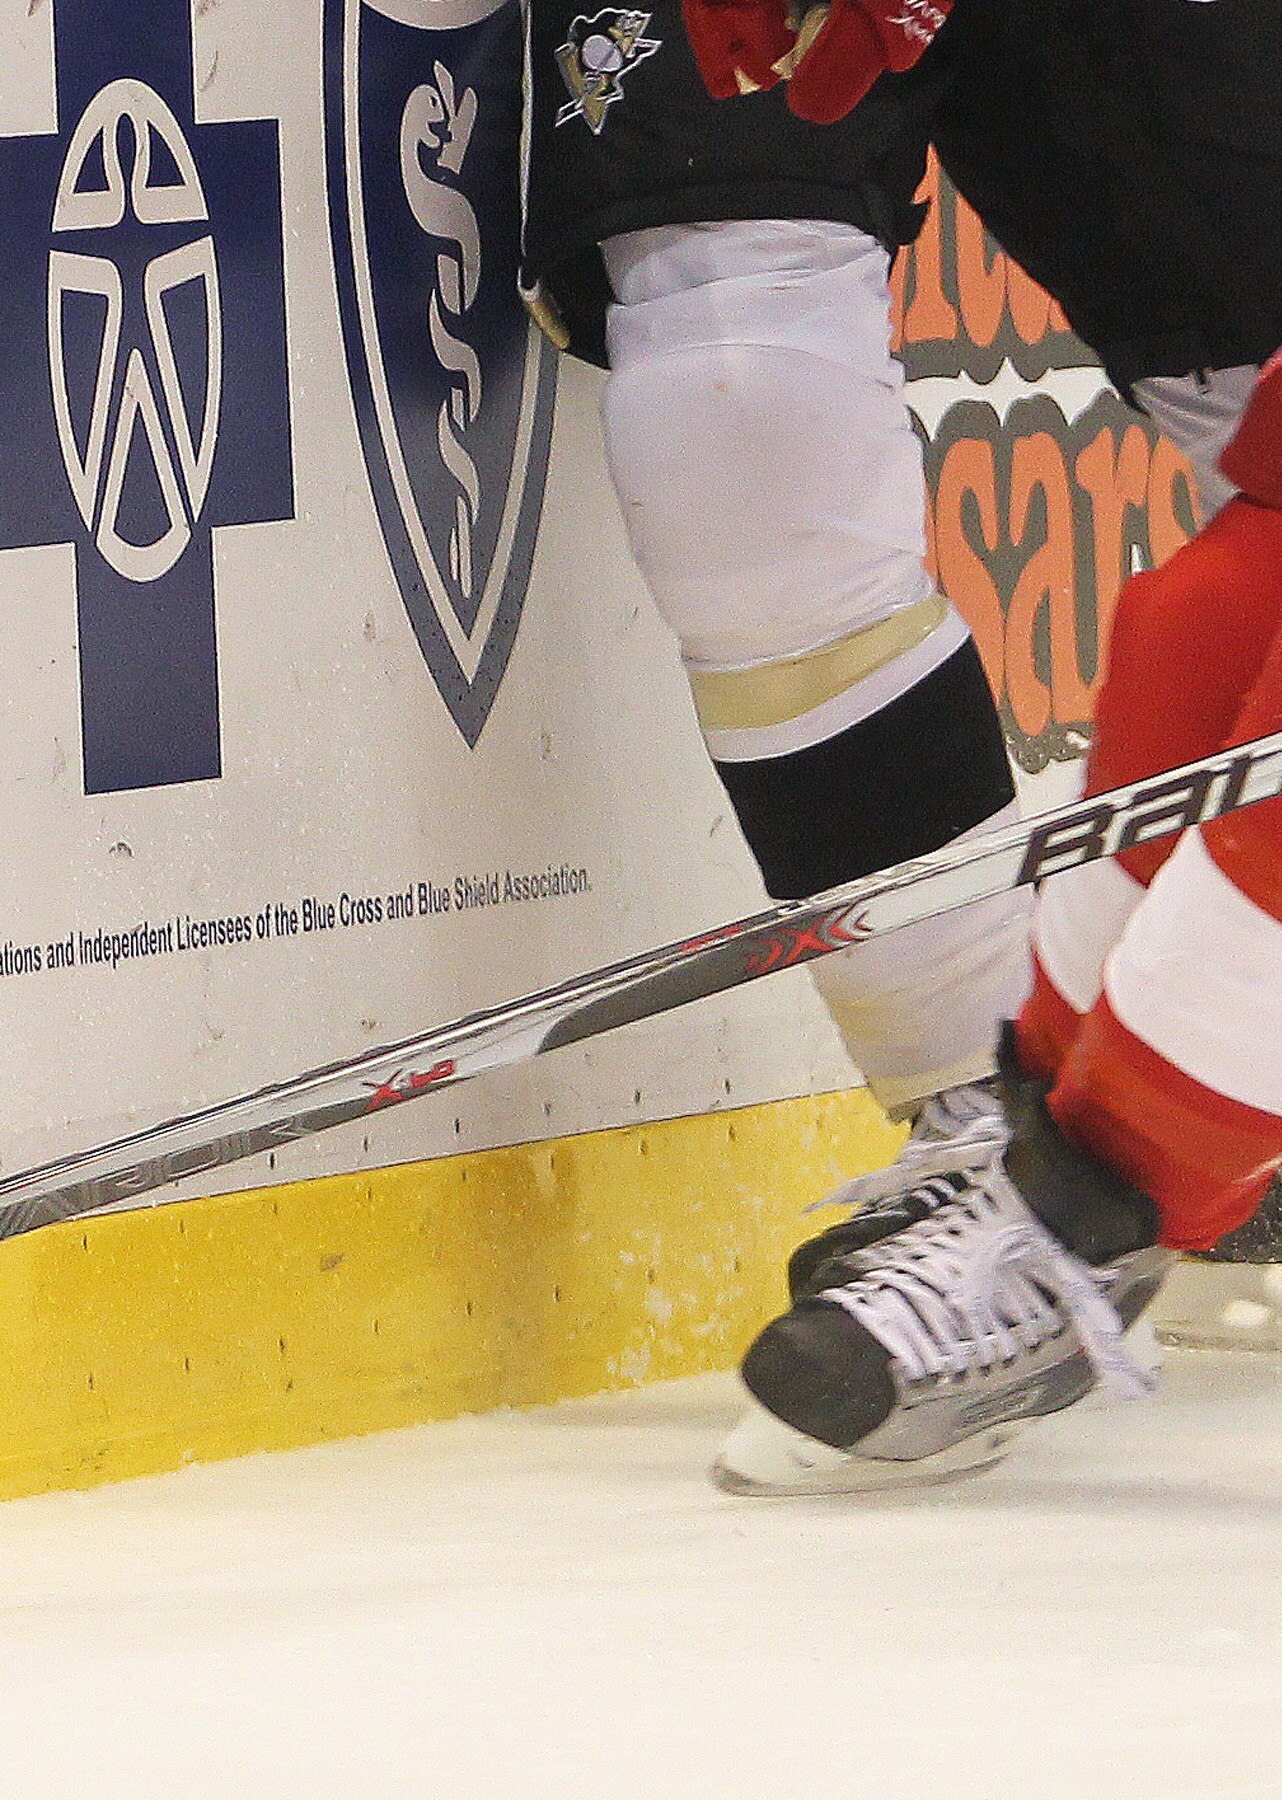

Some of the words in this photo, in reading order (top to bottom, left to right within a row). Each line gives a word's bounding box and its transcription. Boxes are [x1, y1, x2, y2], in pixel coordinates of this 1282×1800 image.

[46, 932, 75, 968] and
[79, 921, 172, 969] Independent
[176, 916, 251, 950] Licensees
[256, 903, 273, 939] of
[274, 903, 298, 937] the
[302, 898, 335, 932] Blue
[339, 893, 382, 927] Cross
[386, 883, 413, 920] and
[418, 882, 450, 915] Blue
[454, 873, 499, 910] Shield
